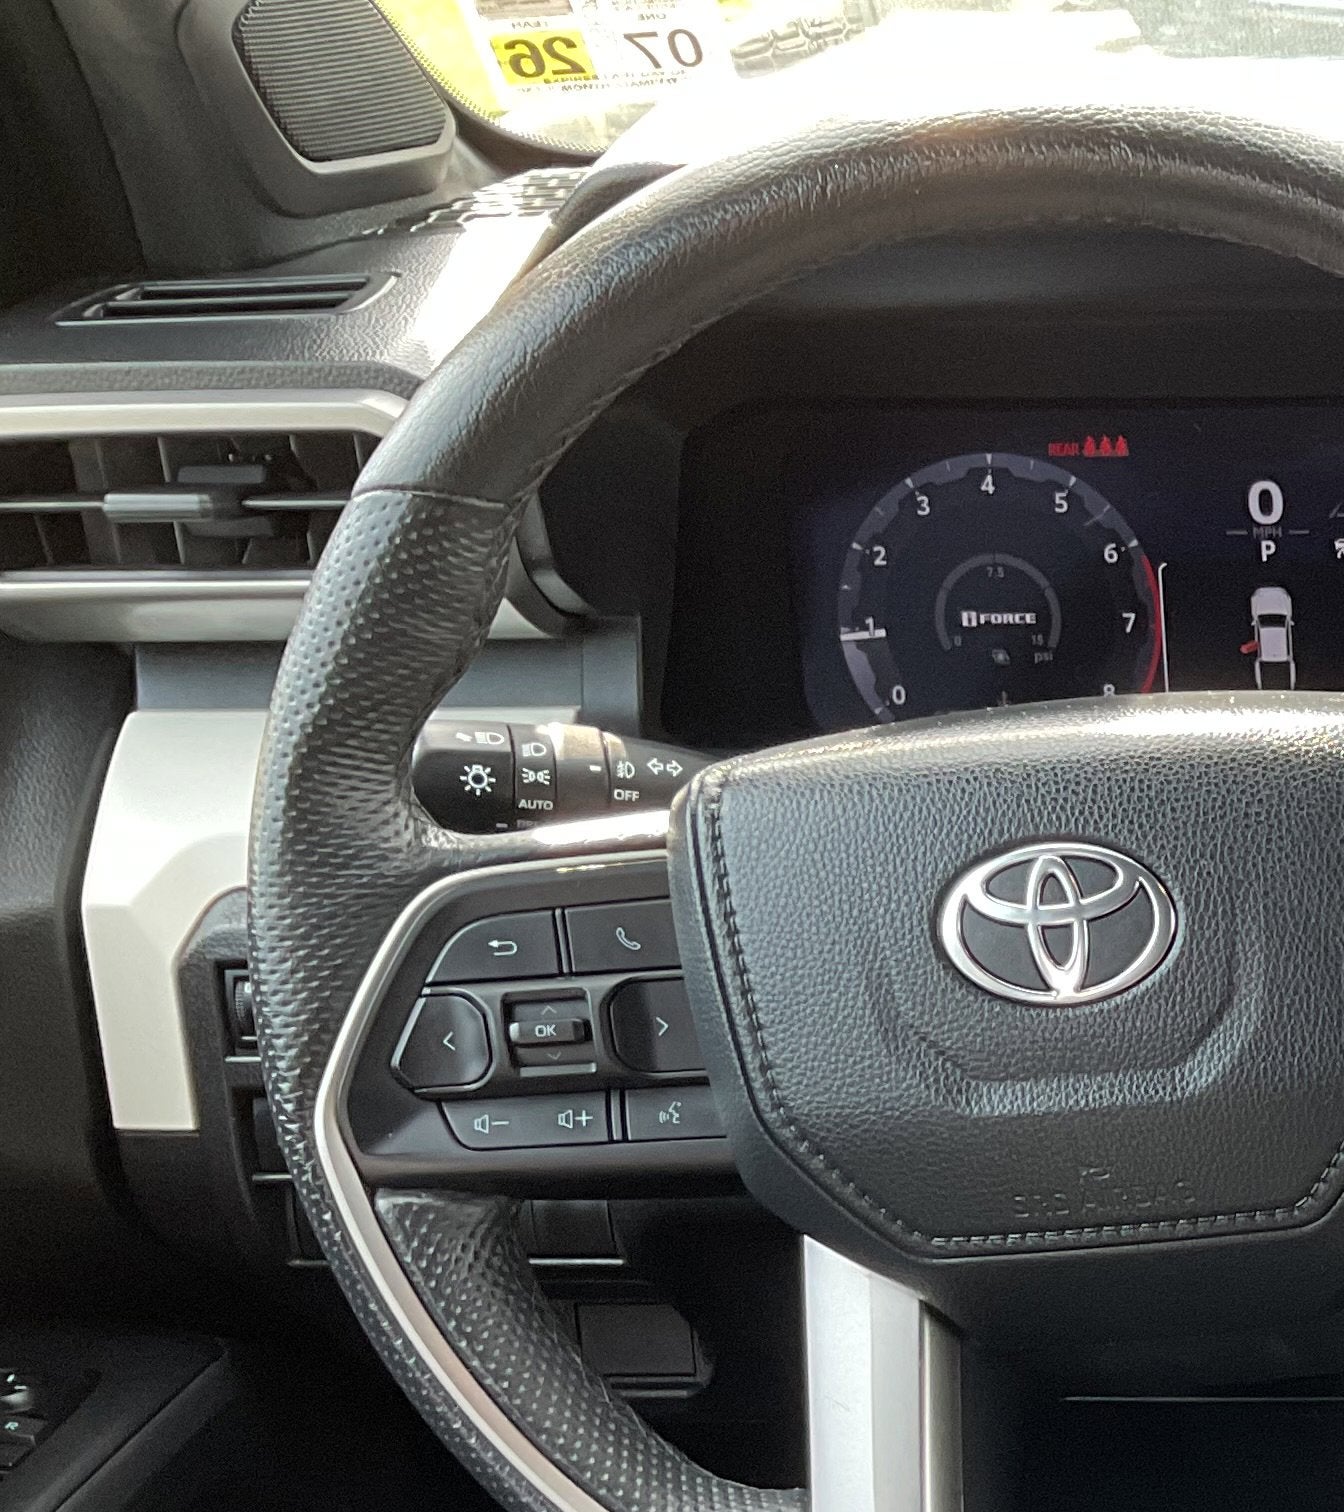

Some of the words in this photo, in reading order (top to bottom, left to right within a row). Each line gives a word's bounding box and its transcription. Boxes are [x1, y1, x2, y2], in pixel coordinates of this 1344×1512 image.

[1048, 442, 1080, 457] REAR
[980, 474, 996, 495] 4
[916, 496, 931, 516] 3
[1054, 491, 1069, 513] 5
[1247, 480, 1284, 526] 0
[1252, 526, 1283, 539] MPH
[873, 546, 887, 566] 2
[1103, 543, 1119, 564] 6
[1260, 539, 1277, 562] P
[864, 616, 876, 637] 1
[1122, 612, 1136, 633] 7
[892, 685, 906, 705] 0
[517, 799, 554, 811] AUTO
[613, 788, 640, 802] OFF
[534, 1024, 557, 1037] OK
